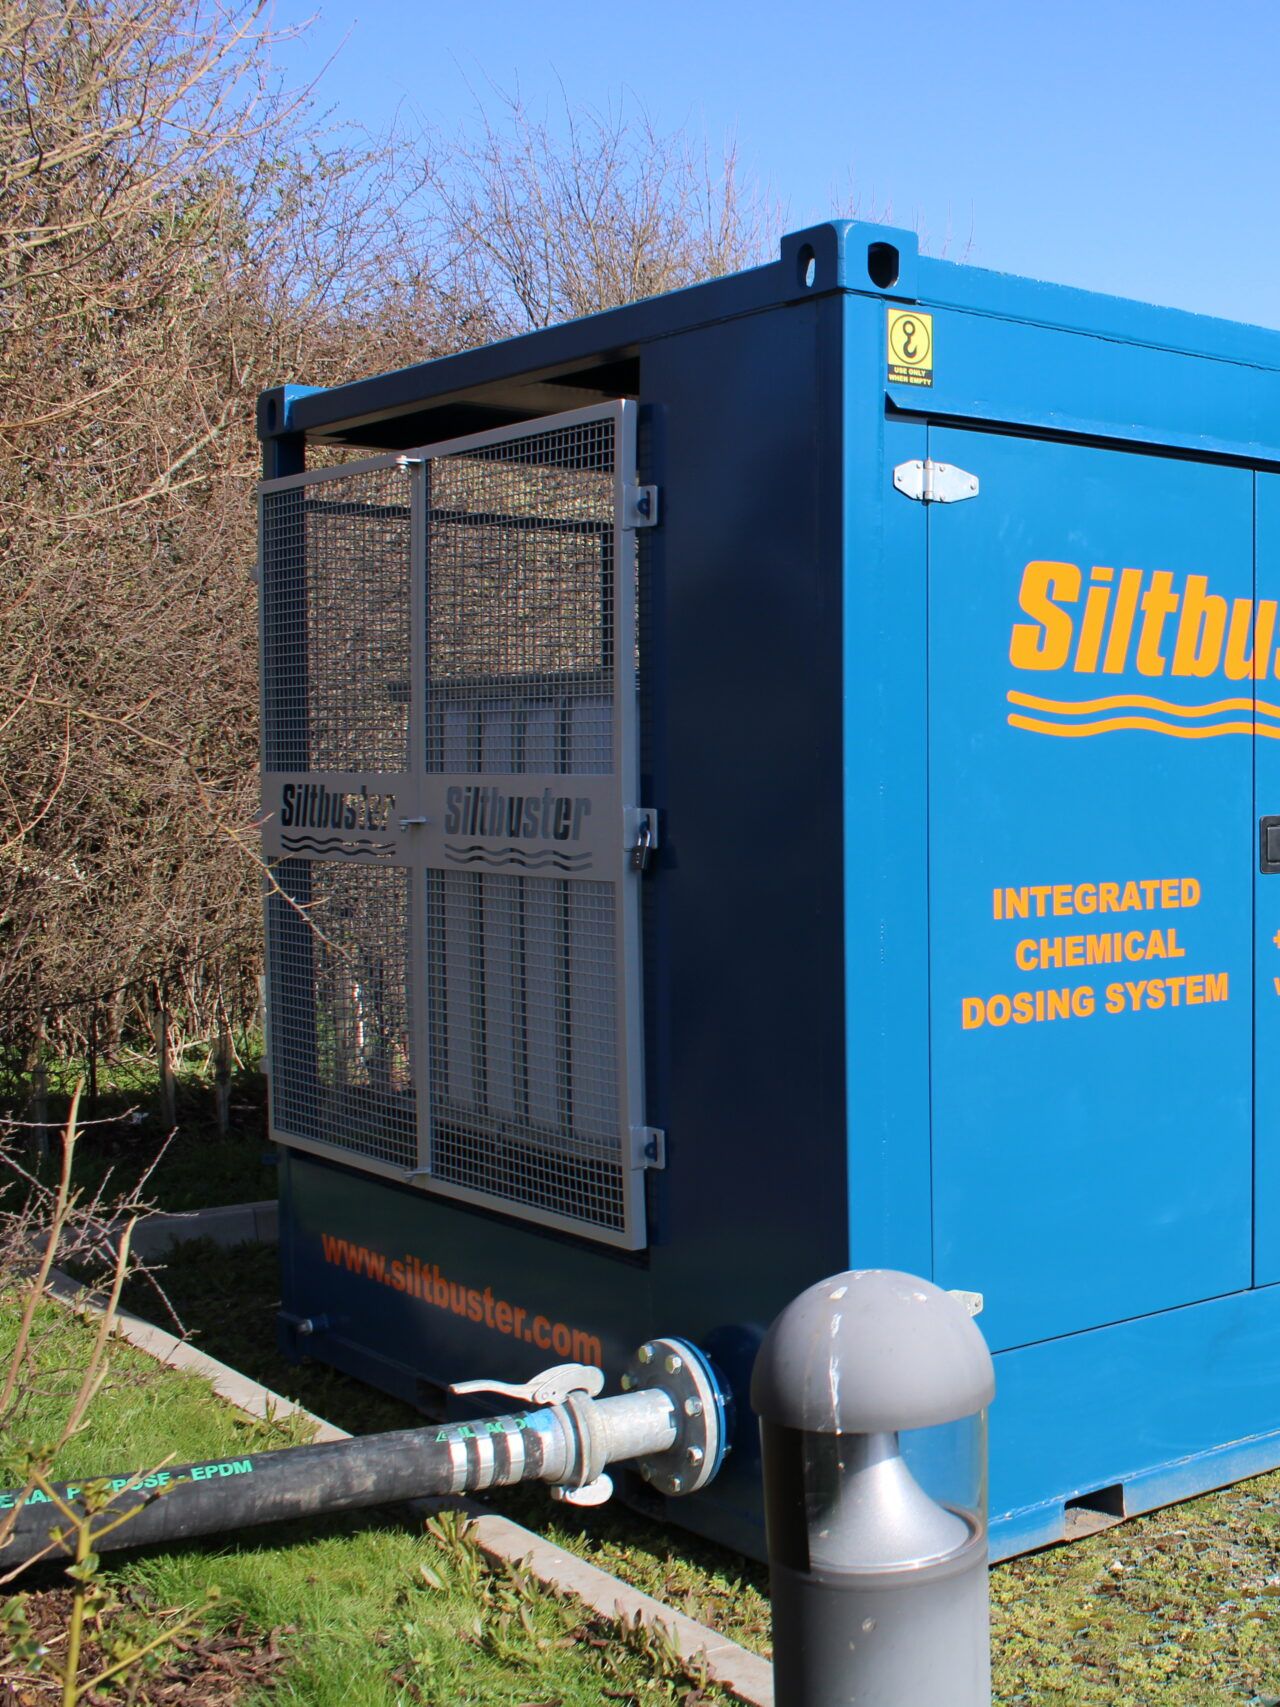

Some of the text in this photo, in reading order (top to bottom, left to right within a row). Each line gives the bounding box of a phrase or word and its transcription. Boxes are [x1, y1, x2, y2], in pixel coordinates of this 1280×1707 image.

[281, 783, 396, 832] Siltbuster
[444, 785, 592, 841] Siltbuster
[993, 878, 1201, 919] INTEGRATED
[1015, 929, 1186, 970] CHEMICAL
[961, 973, 1229, 1029] DOSING SYSTEM
[321, 1233, 603, 1367] www.siltbuster.com
[190, 1460, 253, 1481] EPDM
